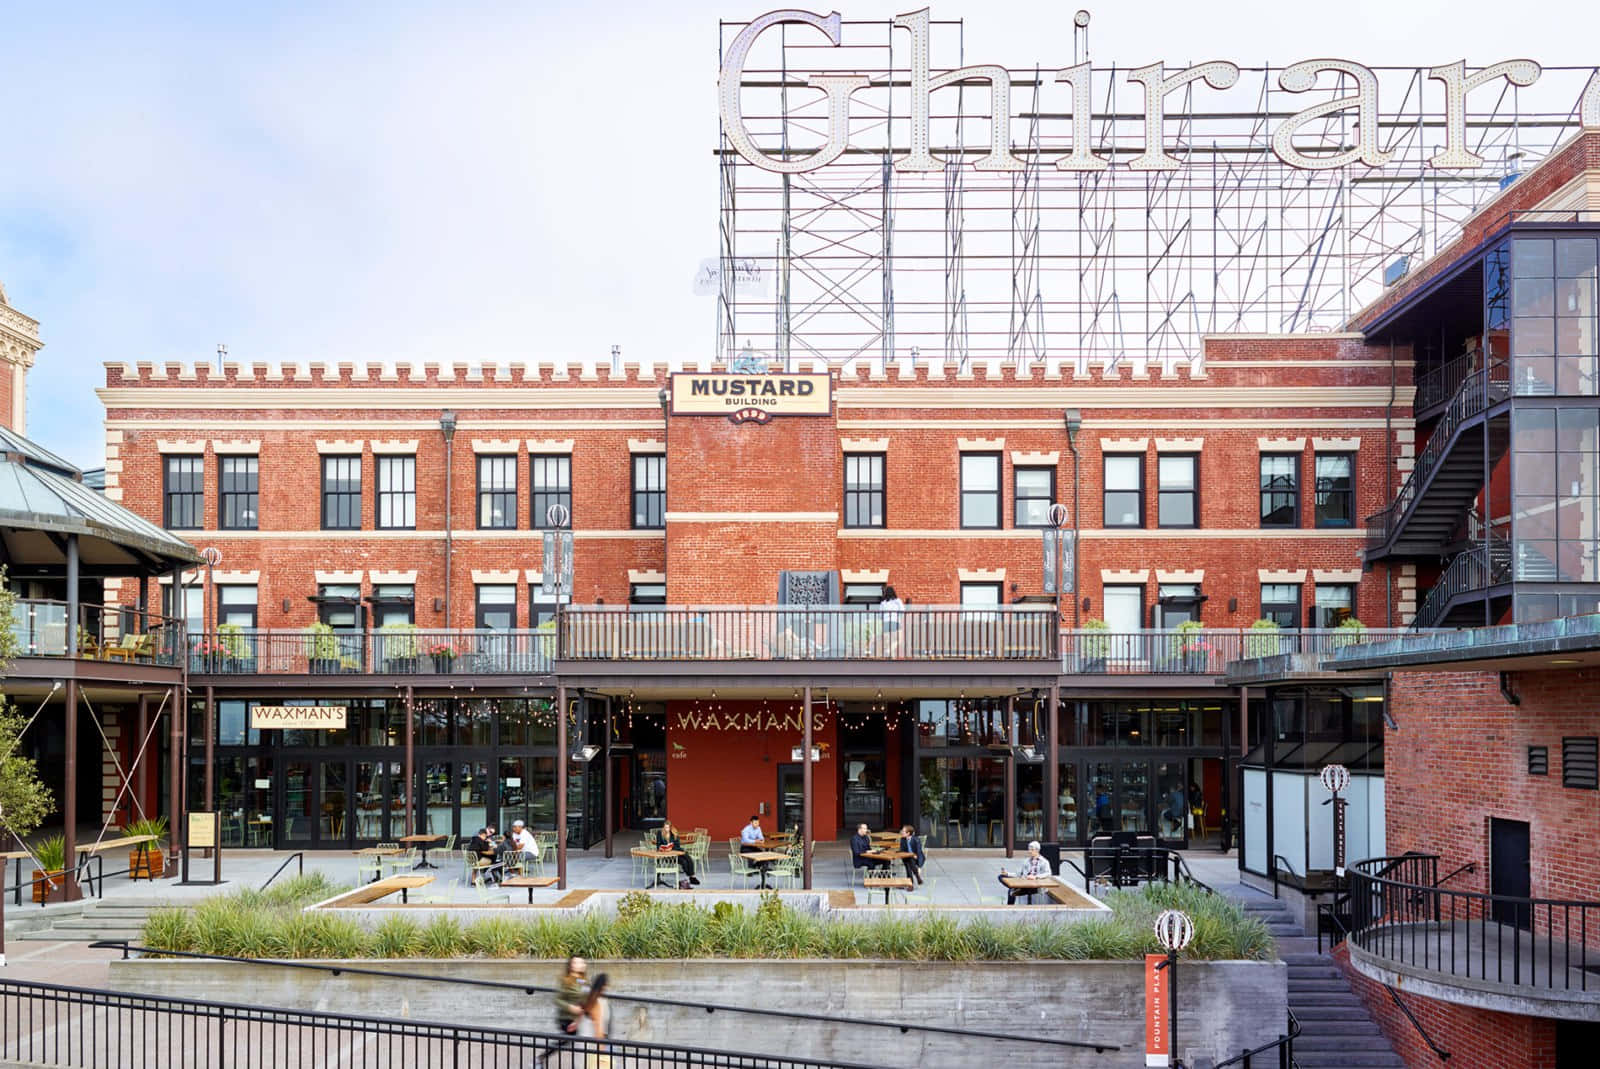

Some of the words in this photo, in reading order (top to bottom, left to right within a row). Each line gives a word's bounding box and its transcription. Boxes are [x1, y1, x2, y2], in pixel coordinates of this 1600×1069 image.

[718, 7, 1600, 172] Ghirar
[691, 379, 814, 396] MUSTARD
[254, 707, 345, 719] WAXMAN'S
[1153, 998, 1161, 1049] FOUNTAIN
